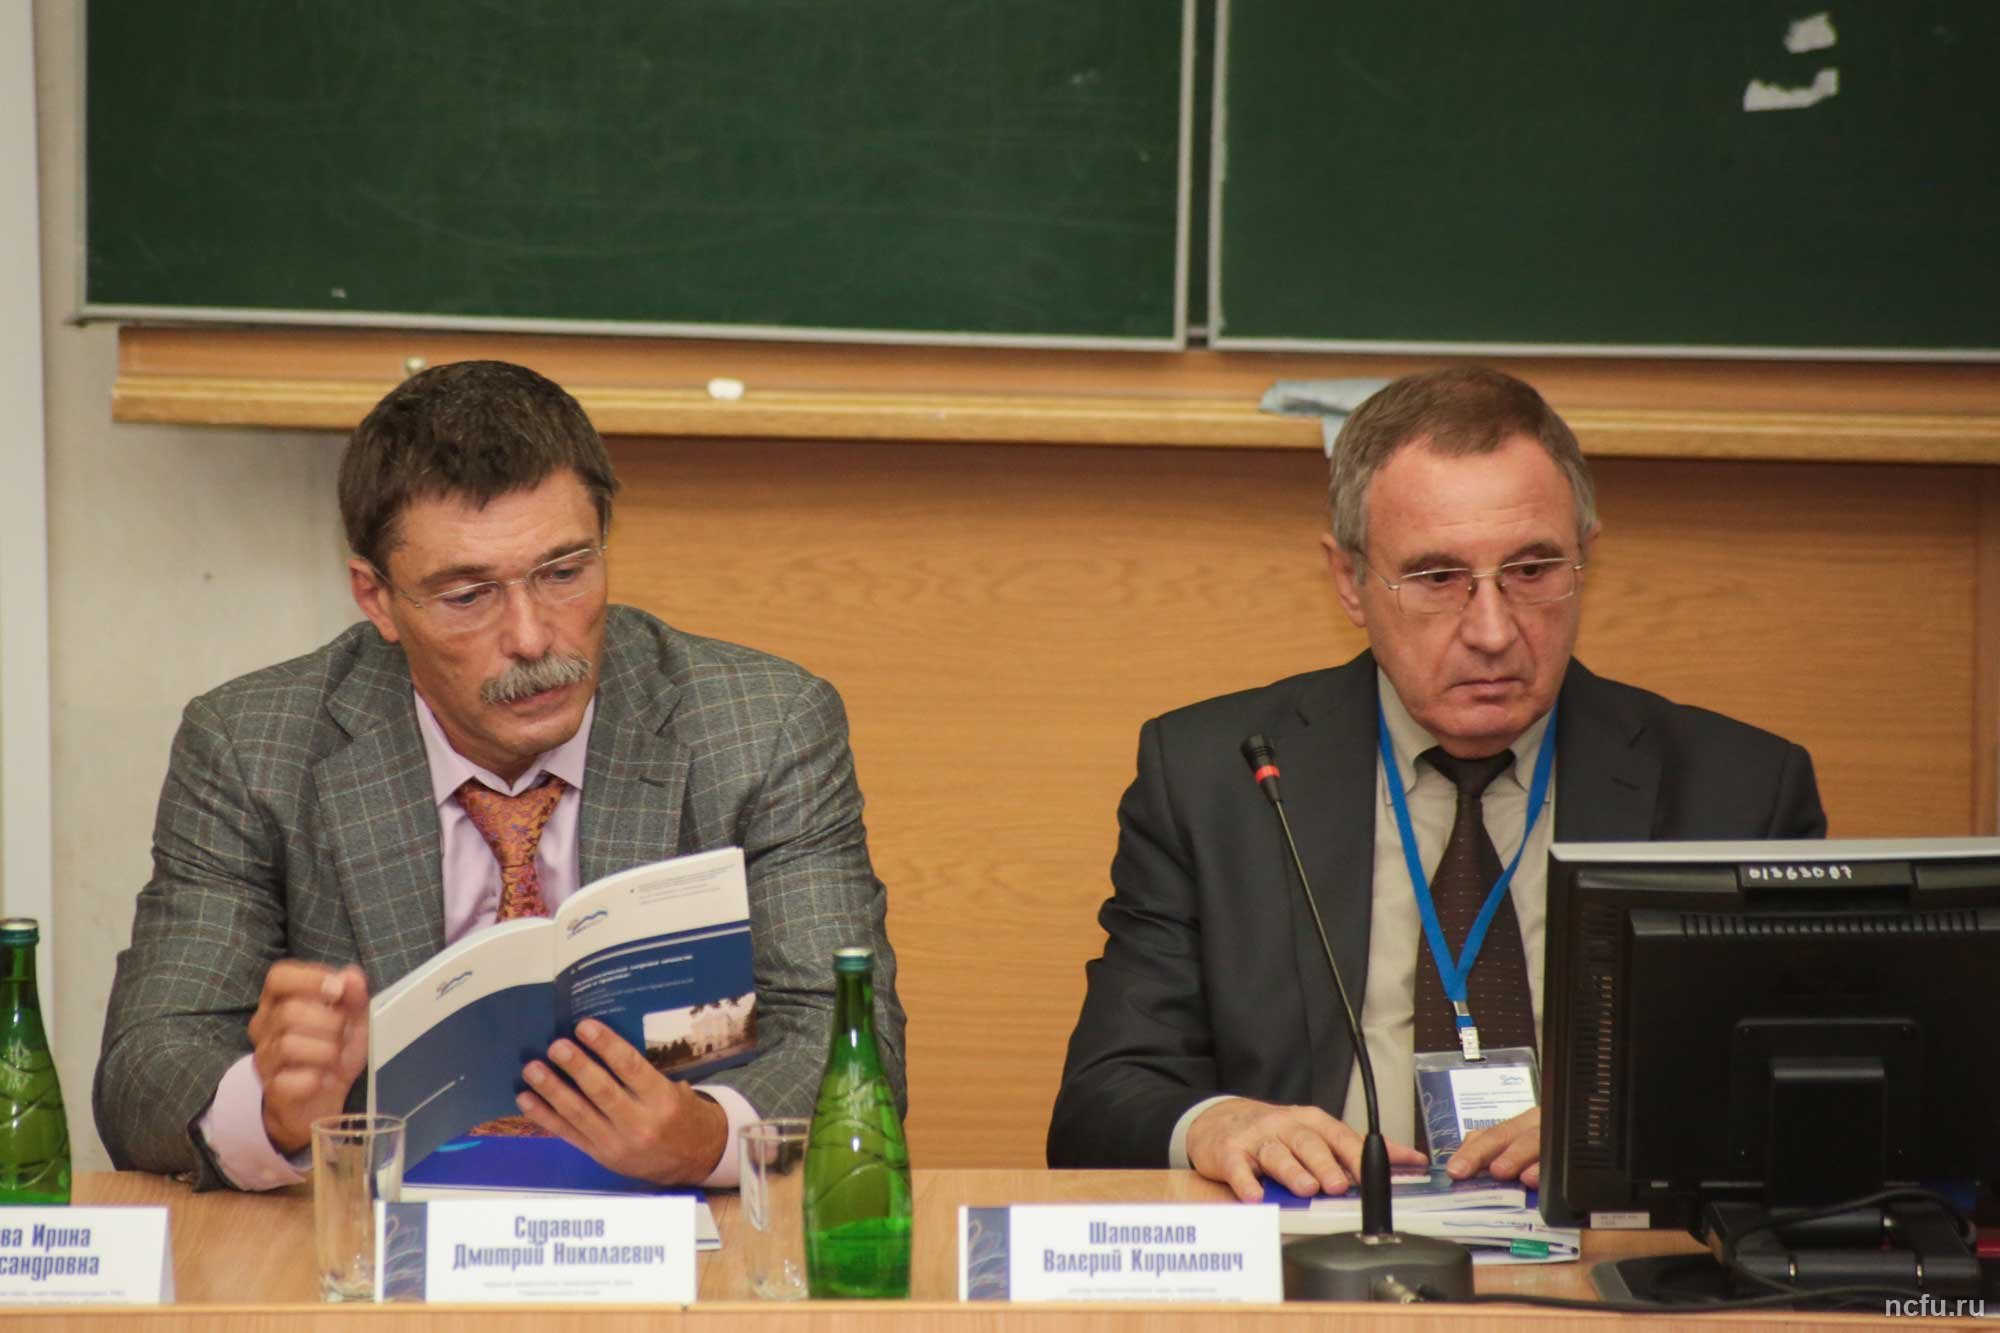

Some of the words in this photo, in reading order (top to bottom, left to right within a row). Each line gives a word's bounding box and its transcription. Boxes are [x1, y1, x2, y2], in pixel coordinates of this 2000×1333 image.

[32, 1223, 91, 1252] Ирина
[514, 1215, 605, 1245] Судавцов
[1088, 1221, 1197, 1245] Шаповалов
[453, 1243, 545, 1271] Дмитрий
[553, 1242, 666, 1265] Николаевич
[1043, 1248, 1122, 1278] Валерий
[1131, 1248, 1243, 1277] Кириллович
